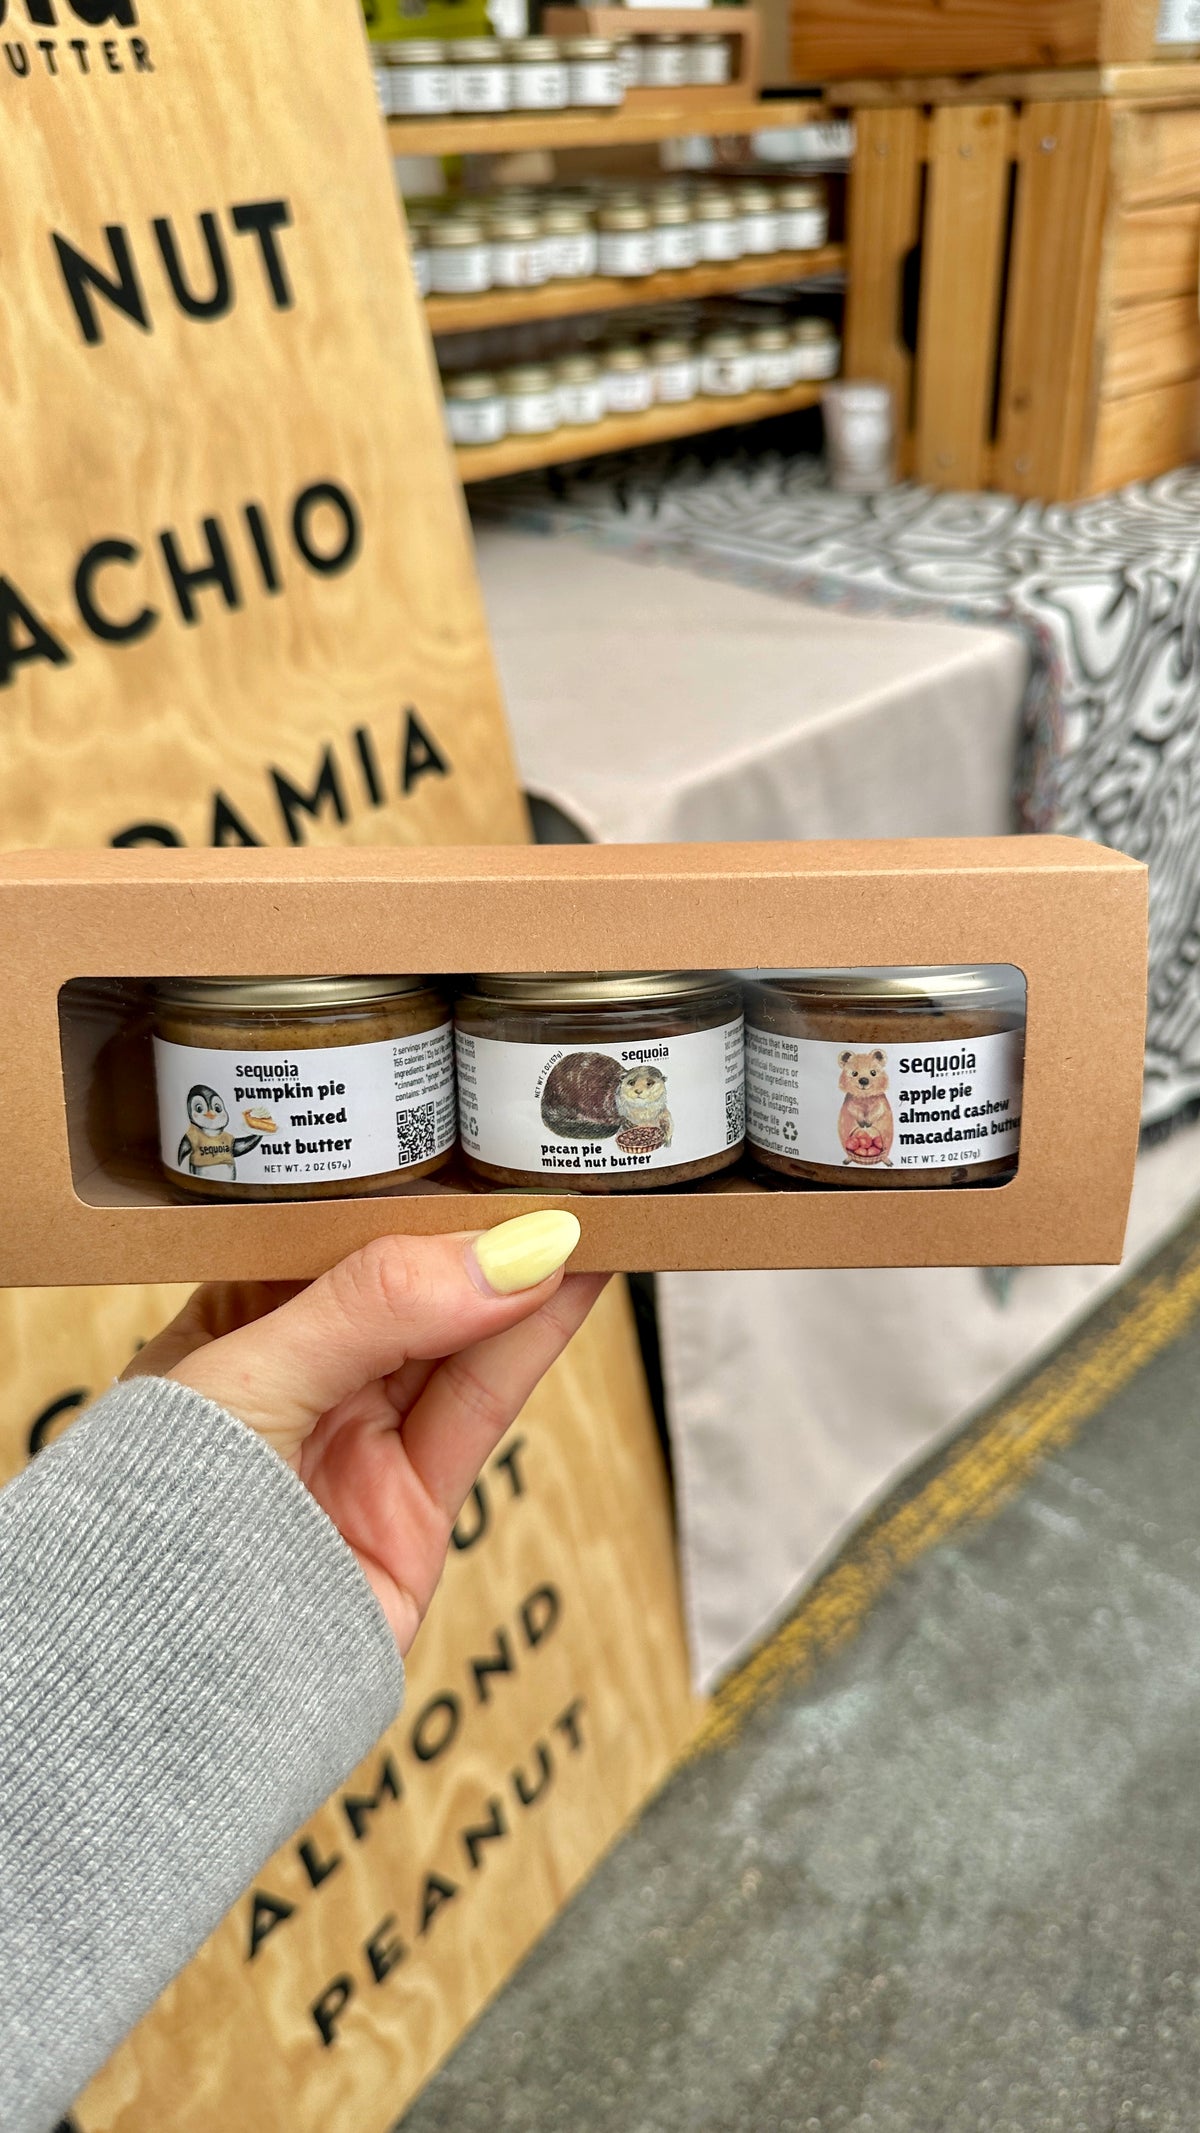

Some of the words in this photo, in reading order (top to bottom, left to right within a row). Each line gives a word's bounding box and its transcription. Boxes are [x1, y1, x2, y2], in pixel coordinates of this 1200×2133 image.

[51, 200, 292, 345] NUT
[0, 481, 360, 690] ACHIO
[621, 1043, 669, 1063] sequoia
[781, 1051, 799, 1062] mind
[782, 1040, 799, 1053] keep
[235, 1060, 299, 1082] sequoia
[899, 1048, 976, 1078] sequoia
[234, 1082, 313, 1102] pumpkin
[318, 1080, 346, 1100] pie
[899, 1085, 945, 1104] apple
[949, 1082, 972, 1102] pie
[290, 1107, 347, 1127] mixed
[899, 1100, 960, 1123] almond
[964, 1099, 1009, 1118] cashew
[899, 1123, 988, 1145] macadamia
[200, 1142, 230, 1157] sequoia
[261, 1141, 292, 1155] nut
[295, 1138, 352, 1154] butter
[541, 1144, 578, 1155] pecan
[582, 1143, 602, 1156] pie
[901, 1156, 918, 1164] NET
[921, 1155, 938, 1163] WT.
[940, 1153, 945, 1162] 2
[947, 1152, 958, 1161] OZ
[960, 1149, 980, 1160] (57g)
[264, 1165, 282, 1173] NET
[285, 1163, 302, 1172] WT.
[305, 1163, 310, 1171] 2
[313, 1162, 325, 1171] OZ
[542, 1156, 581, 1167] mixed
[585, 1157, 607, 1167] nut
[611, 1155, 651, 1166] butter
[248, 1584, 561, 1963] ALMOND
[311, 1700, 585, 2048] PEANUT
